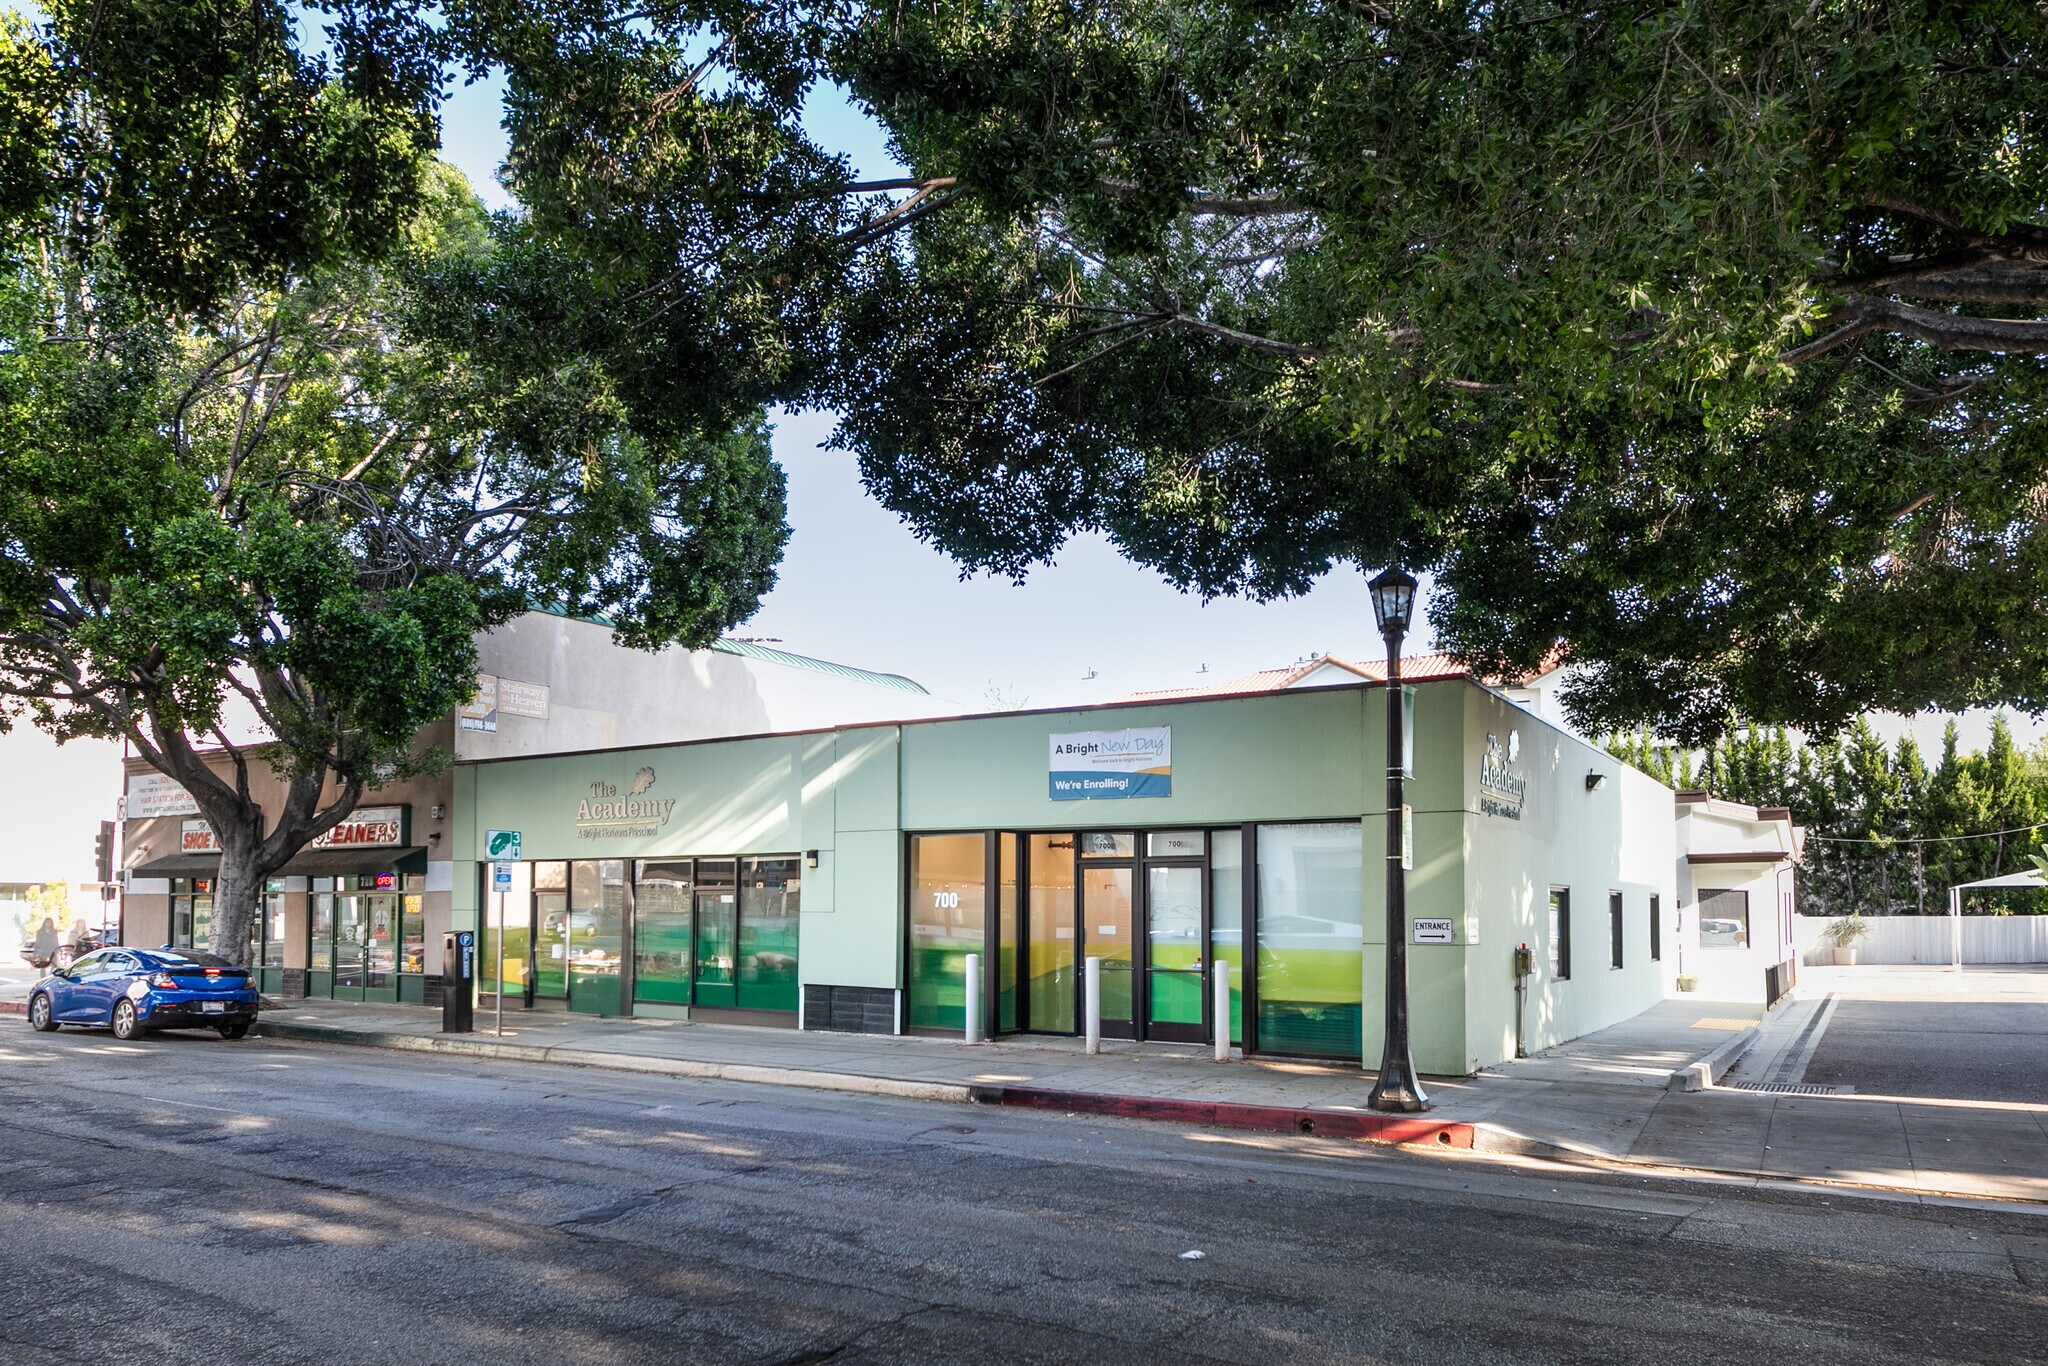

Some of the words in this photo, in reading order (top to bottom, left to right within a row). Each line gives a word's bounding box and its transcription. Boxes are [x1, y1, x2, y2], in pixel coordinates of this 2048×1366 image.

[511, 694, 546, 709] Heaven
[1056, 745, 1063, 754] A
[1066, 742, 1098, 755] Bright
[1101, 739, 1130, 754] New
[1135, 738, 1164, 755] Day
[1487, 732, 1502, 759] The
[1055, 781, 1082, 790] We're
[1083, 778, 1129, 790] Enrolling!
[1480, 754, 1527, 808] Academy
[590, 781, 616, 798] The
[576, 794, 675, 825] Academy
[183, 831, 212, 849] SHOE
[513, 832, 520, 843] 3
[577, 830, 582, 839] A
[377, 876, 393, 886] OPEN
[933, 892, 958, 908] 700
[1415, 922, 1450, 931] ENTRANCE
[464, 935, 470, 944] P
